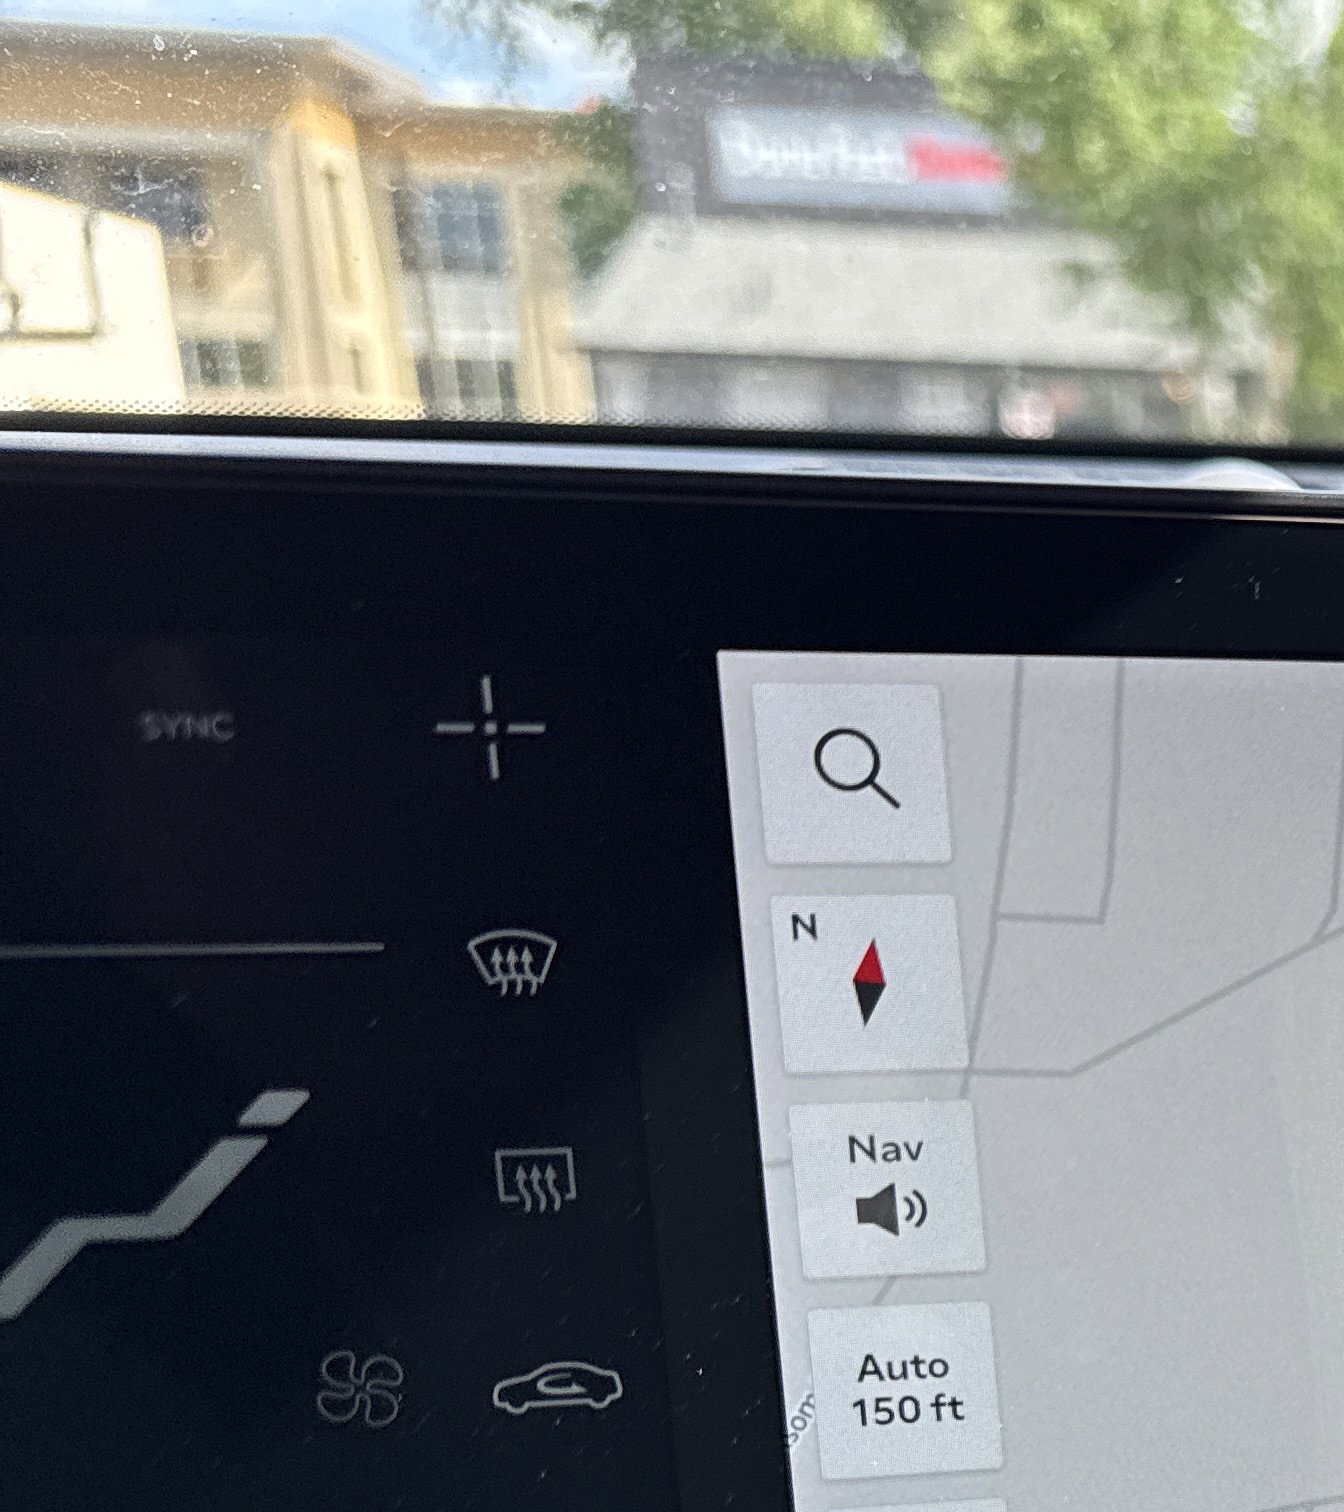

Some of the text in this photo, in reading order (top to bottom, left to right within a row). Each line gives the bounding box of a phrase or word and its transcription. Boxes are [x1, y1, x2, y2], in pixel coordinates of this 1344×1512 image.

[140, 711, 236, 742] SYNC
[791, 913, 818, 941] N
[848, 1134, 923, 1163] Nav
[857, 1354, 950, 1383] Auto
[852, 1393, 965, 1427] 150 ft
